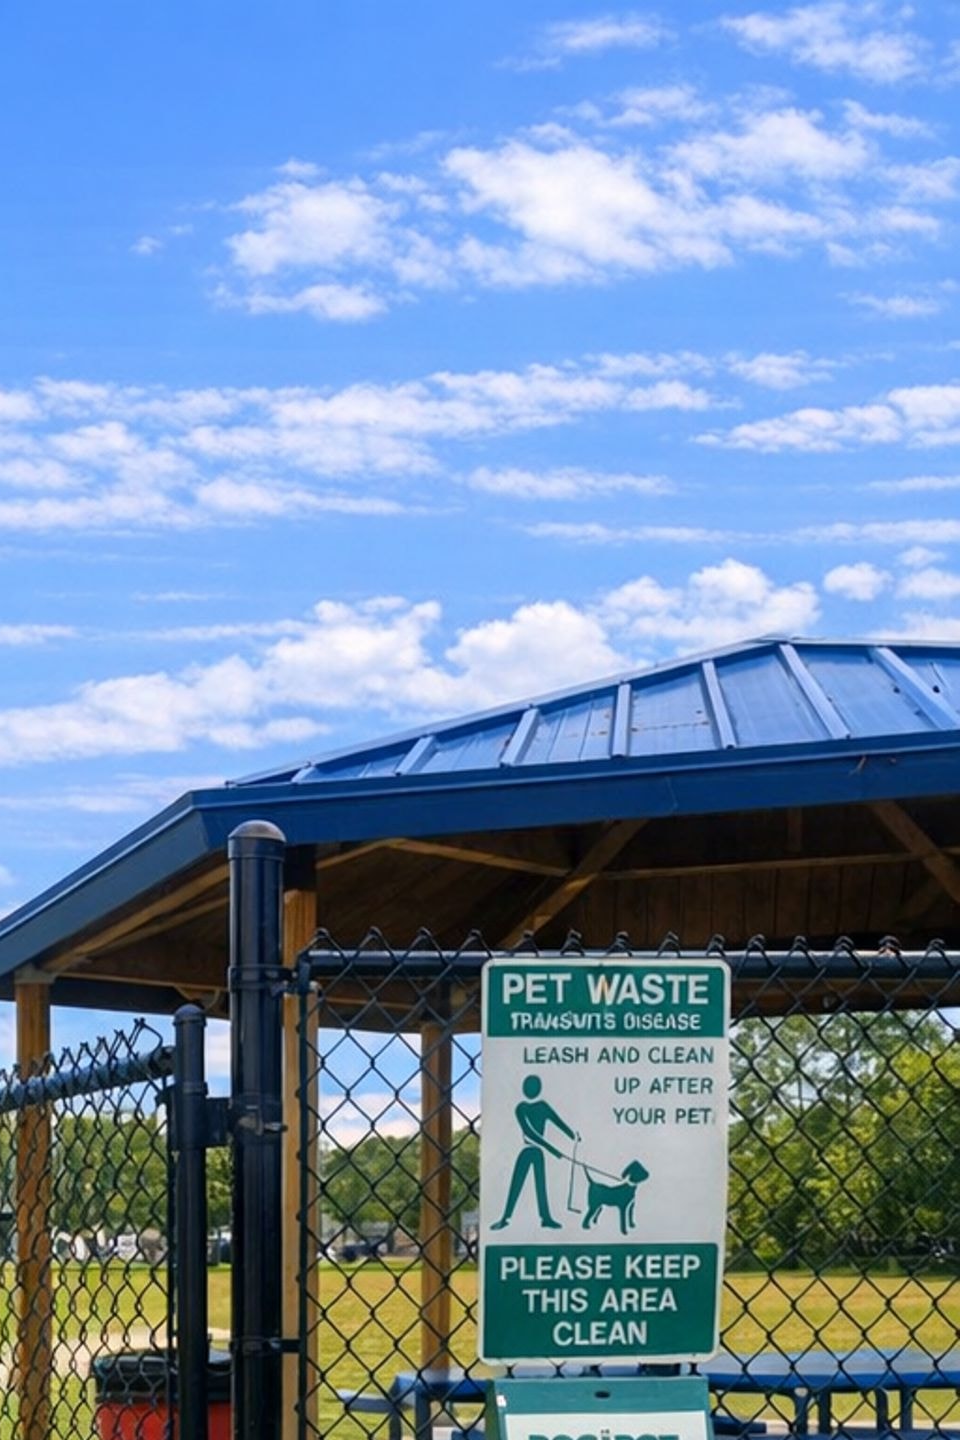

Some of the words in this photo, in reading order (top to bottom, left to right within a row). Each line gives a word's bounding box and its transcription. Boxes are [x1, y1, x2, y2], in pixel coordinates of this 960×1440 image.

[503, 973, 572, 1004] PET
[587, 973, 709, 1005] WASTE
[623, 1012, 701, 1030] DISEASE
[523, 1046, 589, 1064] LEASH
[597, 1046, 640, 1063] AND
[648, 1046, 714, 1063] CLEAN
[614, 1077, 640, 1094] UP
[649, 1077, 714, 1094] AFTER
[613, 1108, 666, 1125] YOUR
[501, 1255, 612, 1280] PLEASE
[625, 1254, 701, 1278] KEEP
[522, 1288, 589, 1313] THIS
[600, 1287, 677, 1312] AREA
[553, 1321, 647, 1346] CLEAN
